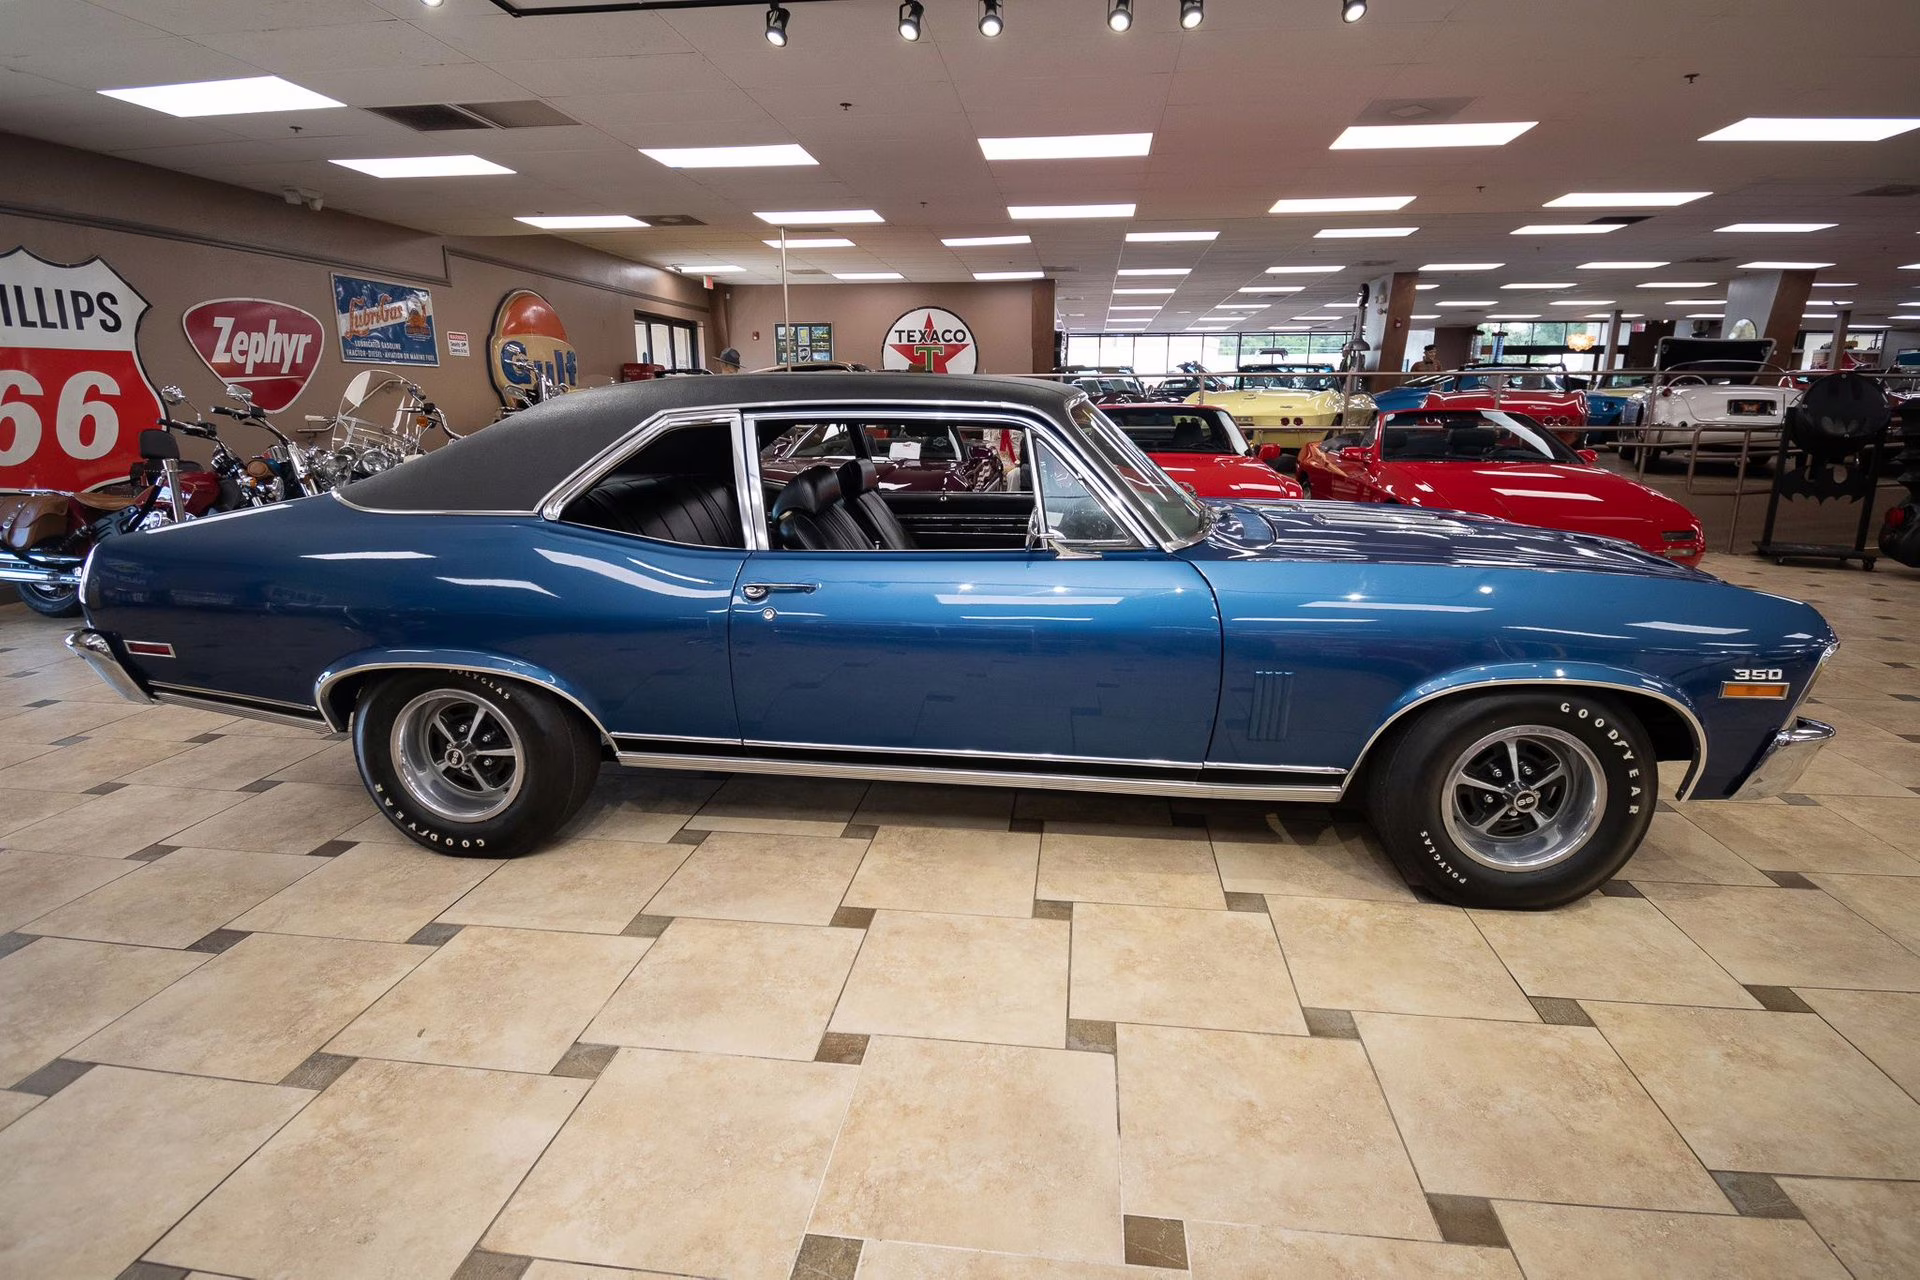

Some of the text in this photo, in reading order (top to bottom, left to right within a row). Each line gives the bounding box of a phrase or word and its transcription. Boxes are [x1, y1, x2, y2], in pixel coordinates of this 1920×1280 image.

[211, 316, 312, 375] Zephyr
[381, 341, 402, 350] GASOLINE
[894, 329, 967, 343] TEXACO
[914, 345, 944, 372] T
[501, 341, 577, 387] Gulf
[0, 369, 121, 467] 66
[448, 669, 510, 700] OLYGLAS
[1734, 668, 1783, 680] 350
[1560, 702, 1641, 816] GOODYEAR
[374, 783, 486, 848] GOODYEAR
[1420, 830, 1467, 885] POLYGLAS
